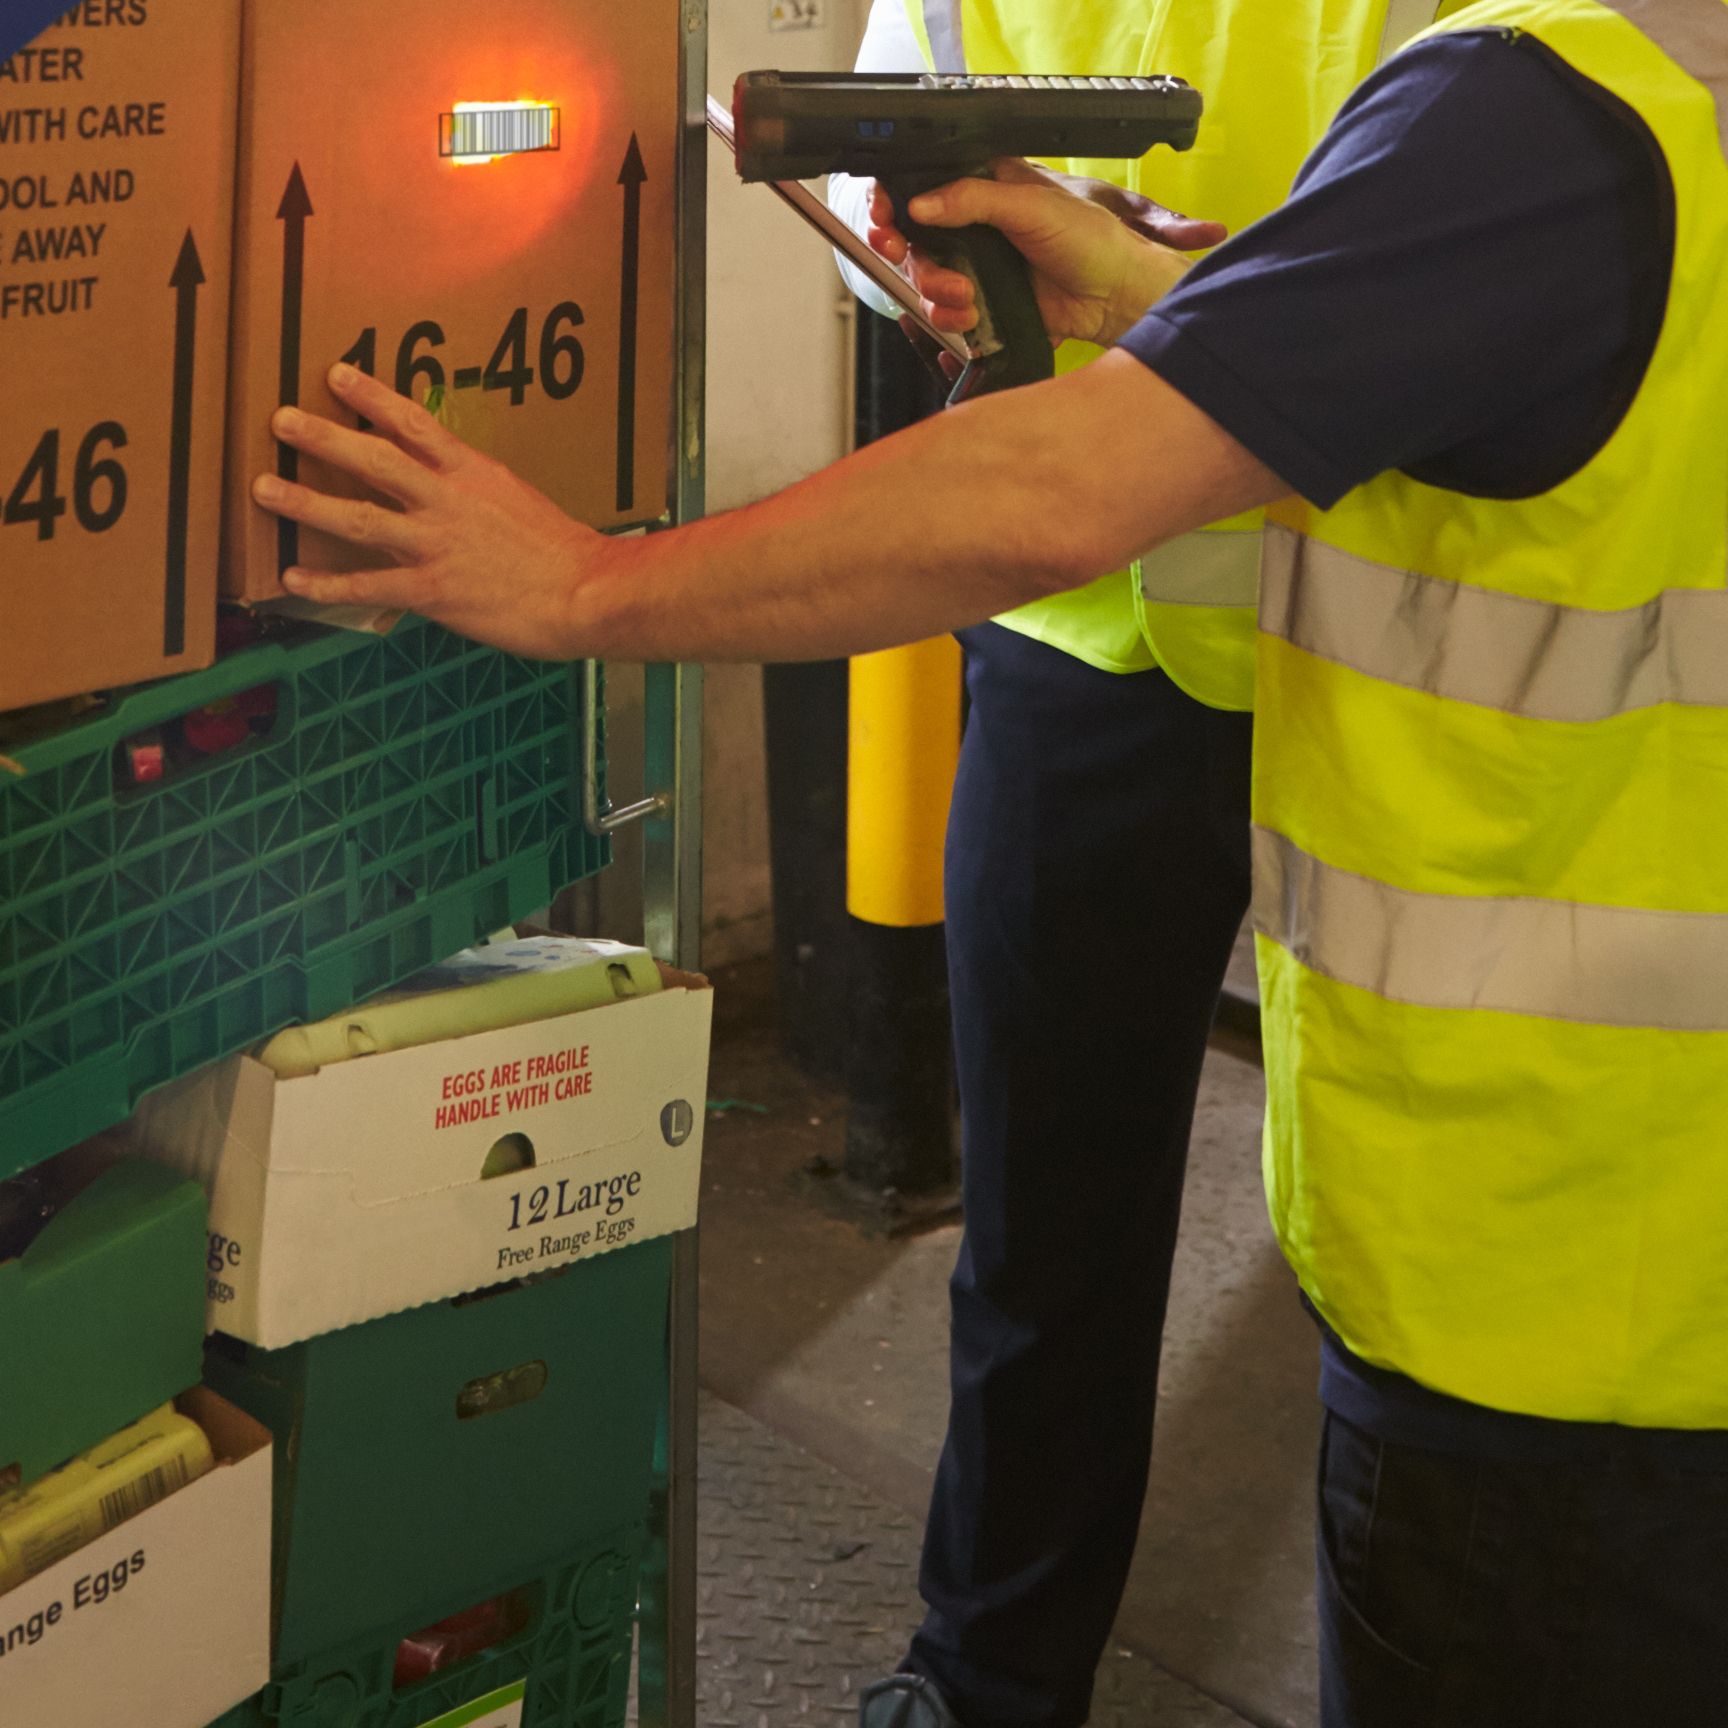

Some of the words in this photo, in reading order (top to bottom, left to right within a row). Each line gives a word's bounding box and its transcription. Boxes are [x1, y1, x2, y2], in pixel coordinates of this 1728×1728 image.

[77, 102, 166, 141] CARE
[66, 168, 135, 207] AND
[10, 223, 108, 265] AWAY
[0, 276, 99, 322] FRUIT
[441, 1068, 486, 1101] EGGS
[490, 1061, 522, 1090] ARE
[526, 1045, 590, 1082] FRAGILE
[435, 1093, 501, 1130] HANDLE
[506, 1082, 550, 1112] WITH
[554, 1071, 593, 1101] CARE
[671, 1106, 685, 1140] L
[506, 1184, 550, 1232] 12
[553, 1170, 642, 1216] Large
[496, 1246, 534, 1270] Free
[538, 1229, 591, 1256] Range
[594, 1215, 636, 1244] Eggs
[72, 1547, 147, 1609] Eggs
